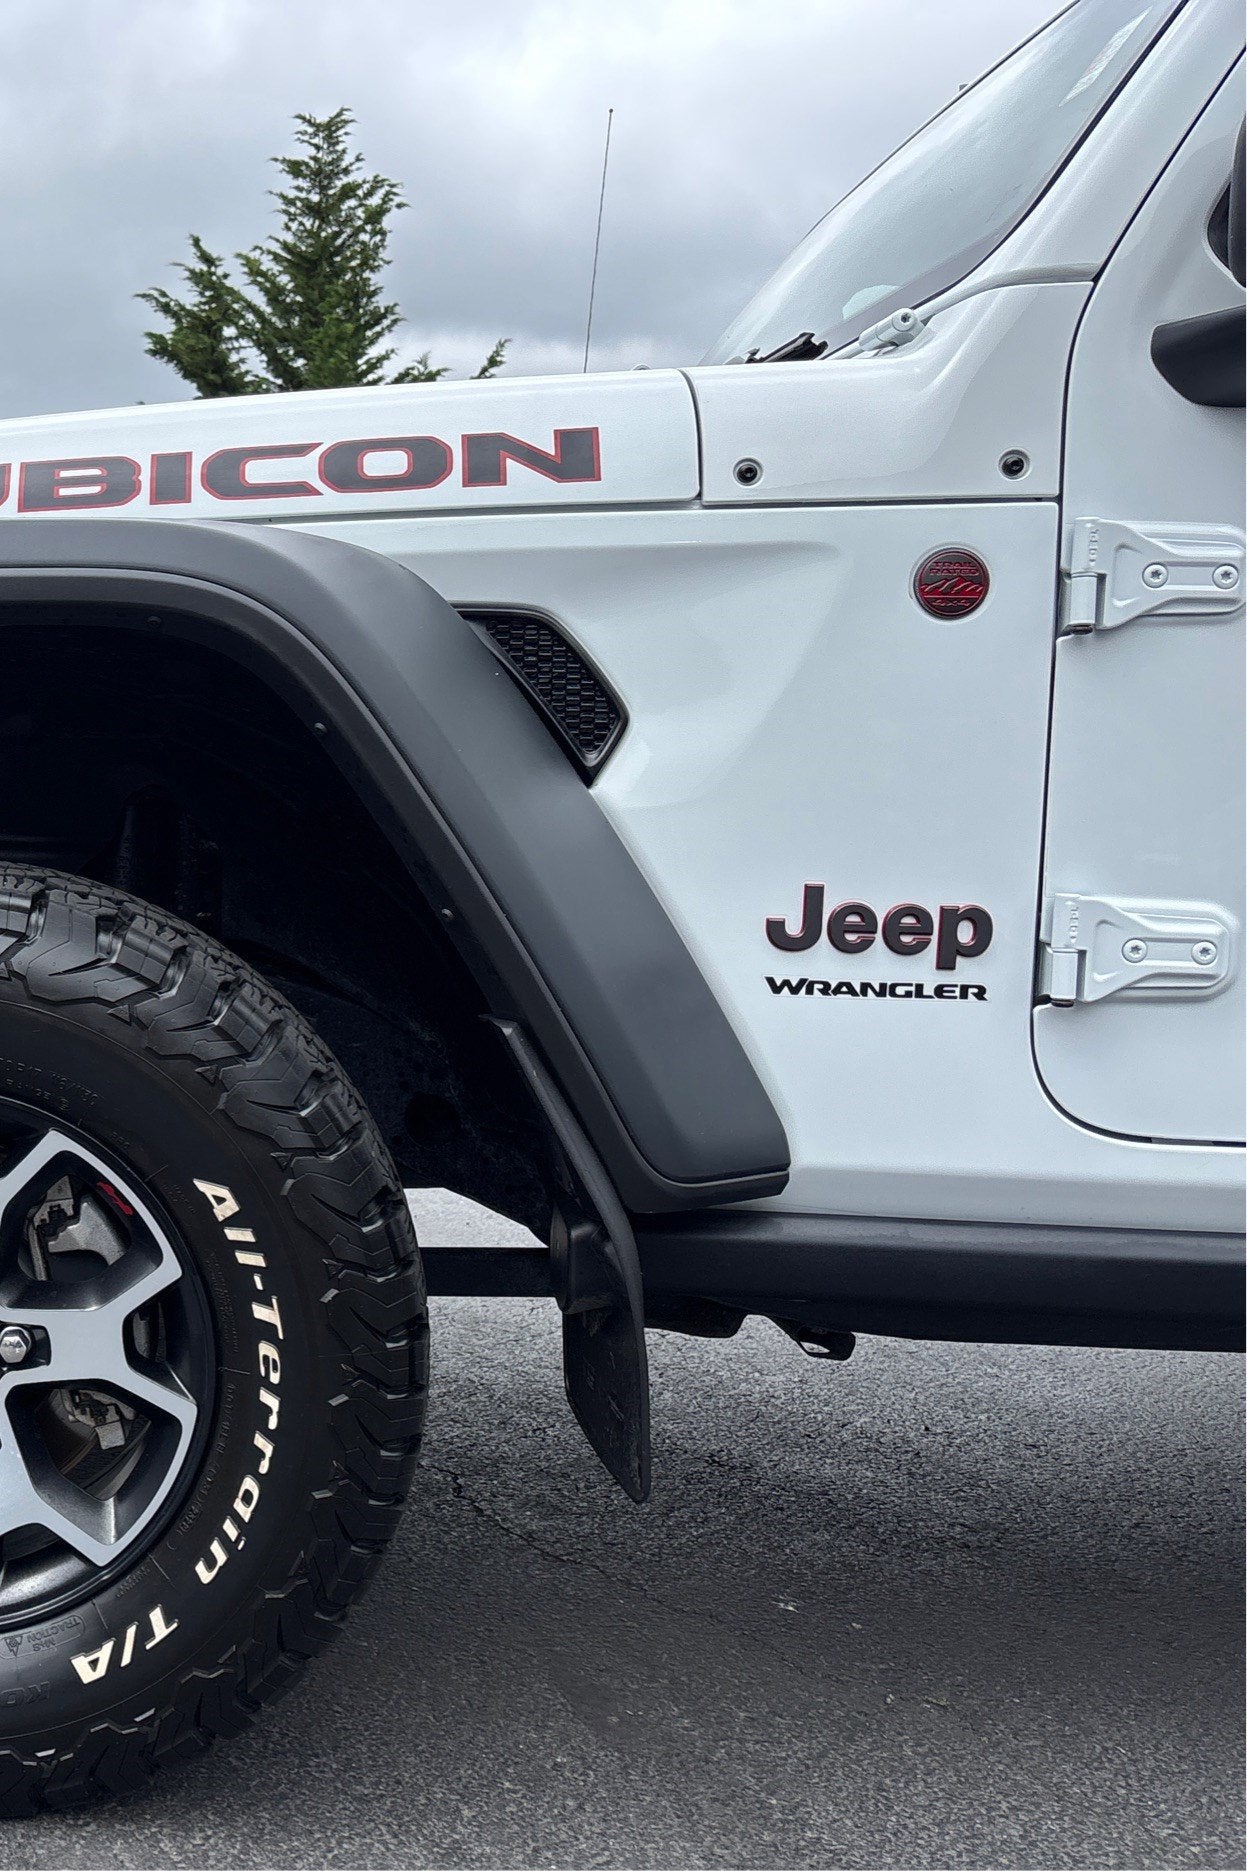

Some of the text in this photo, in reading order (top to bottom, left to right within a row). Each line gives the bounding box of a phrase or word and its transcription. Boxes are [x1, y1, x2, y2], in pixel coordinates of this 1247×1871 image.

[929, 568, 980, 576] RATED
[765, 883, 994, 971] Jeep
[764, 976, 989, 1002] WRANGLER
[193, 1179, 285, 1586] All-Terrain
[27, 1617, 81, 1643] TRACTION
[70, 1606, 180, 1686] T/A
